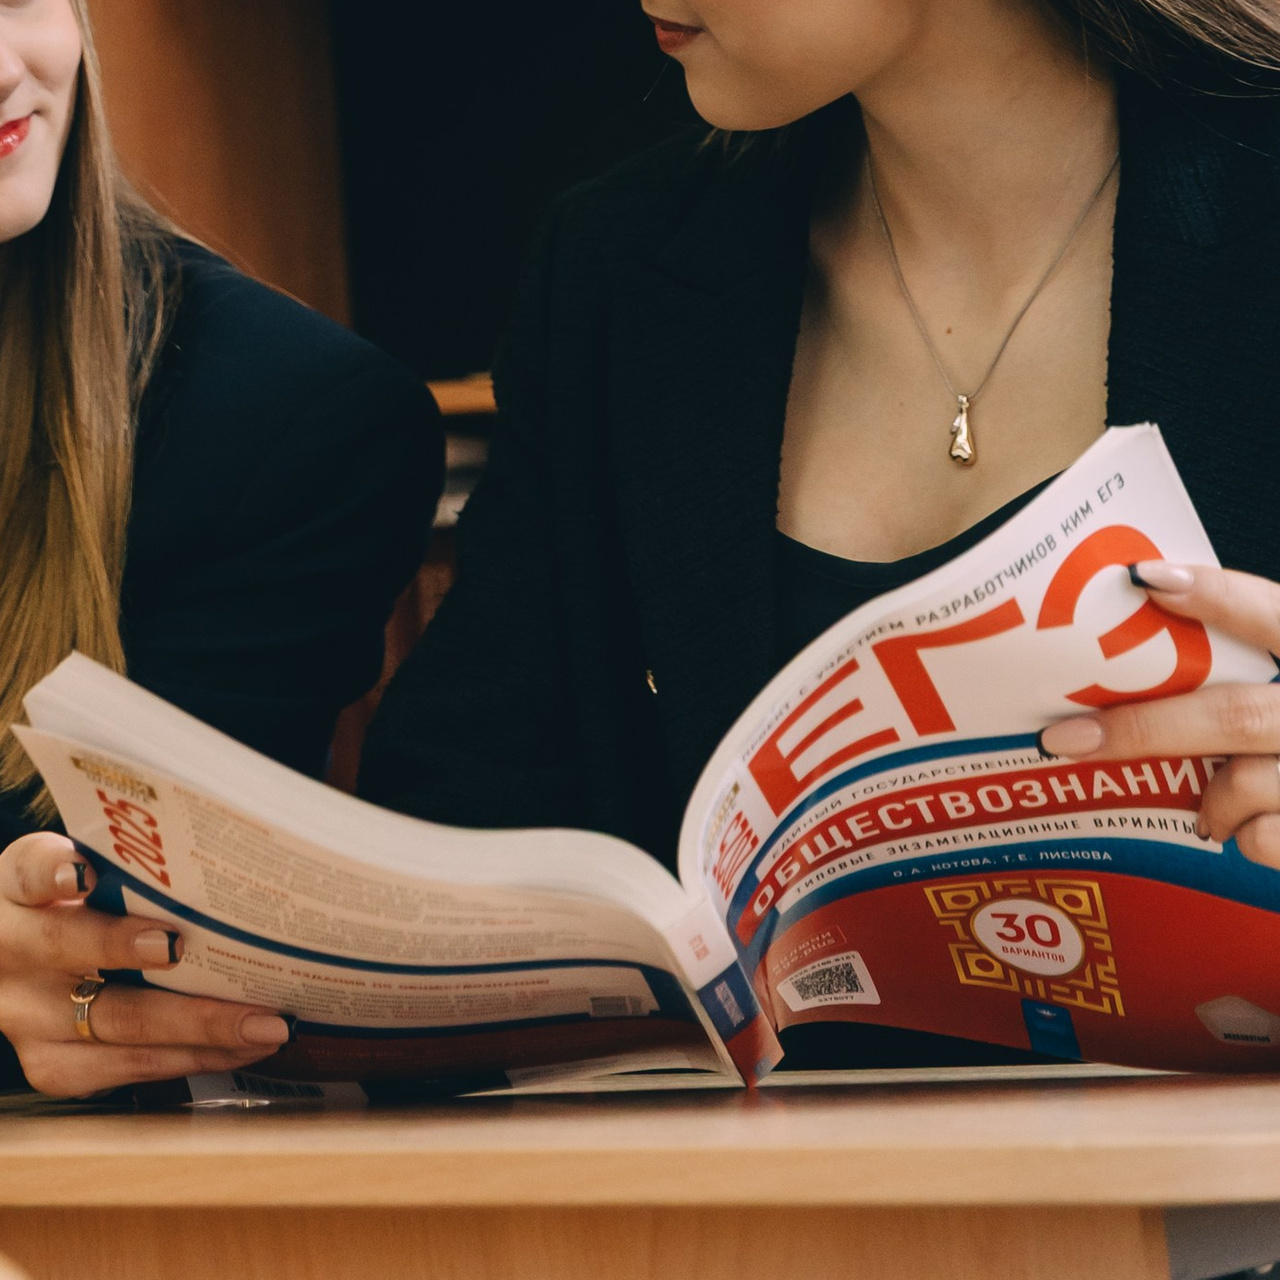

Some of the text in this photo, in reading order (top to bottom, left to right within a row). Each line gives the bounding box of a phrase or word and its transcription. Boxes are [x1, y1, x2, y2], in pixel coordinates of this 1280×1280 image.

[915, 534, 1058, 627] РАЗРАБОТЧИКОВ
[1060, 502, 1094, 538] КИМ
[1097, 472, 1126, 505] ЕГЭ
[748, 525, 1213, 818] ЕГЭ
[95, 788, 172, 889] 2025
[771, 799, 843, 860] ЕДИНЫЙ
[851, 753, 1060, 800] ГОСУДАРСТВЕННЫЙ
[796, 816, 1198, 895] ТИПОВЫЕ ЭКЗАМЕНАЦИОННЫЕ ВАРИАНТЫ
[1039, 850, 1113, 861] ЛИСКОВА
[990, 913, 1062, 948] 30
[1001, 945, 1066, 963] ВАРИАНТОВ
